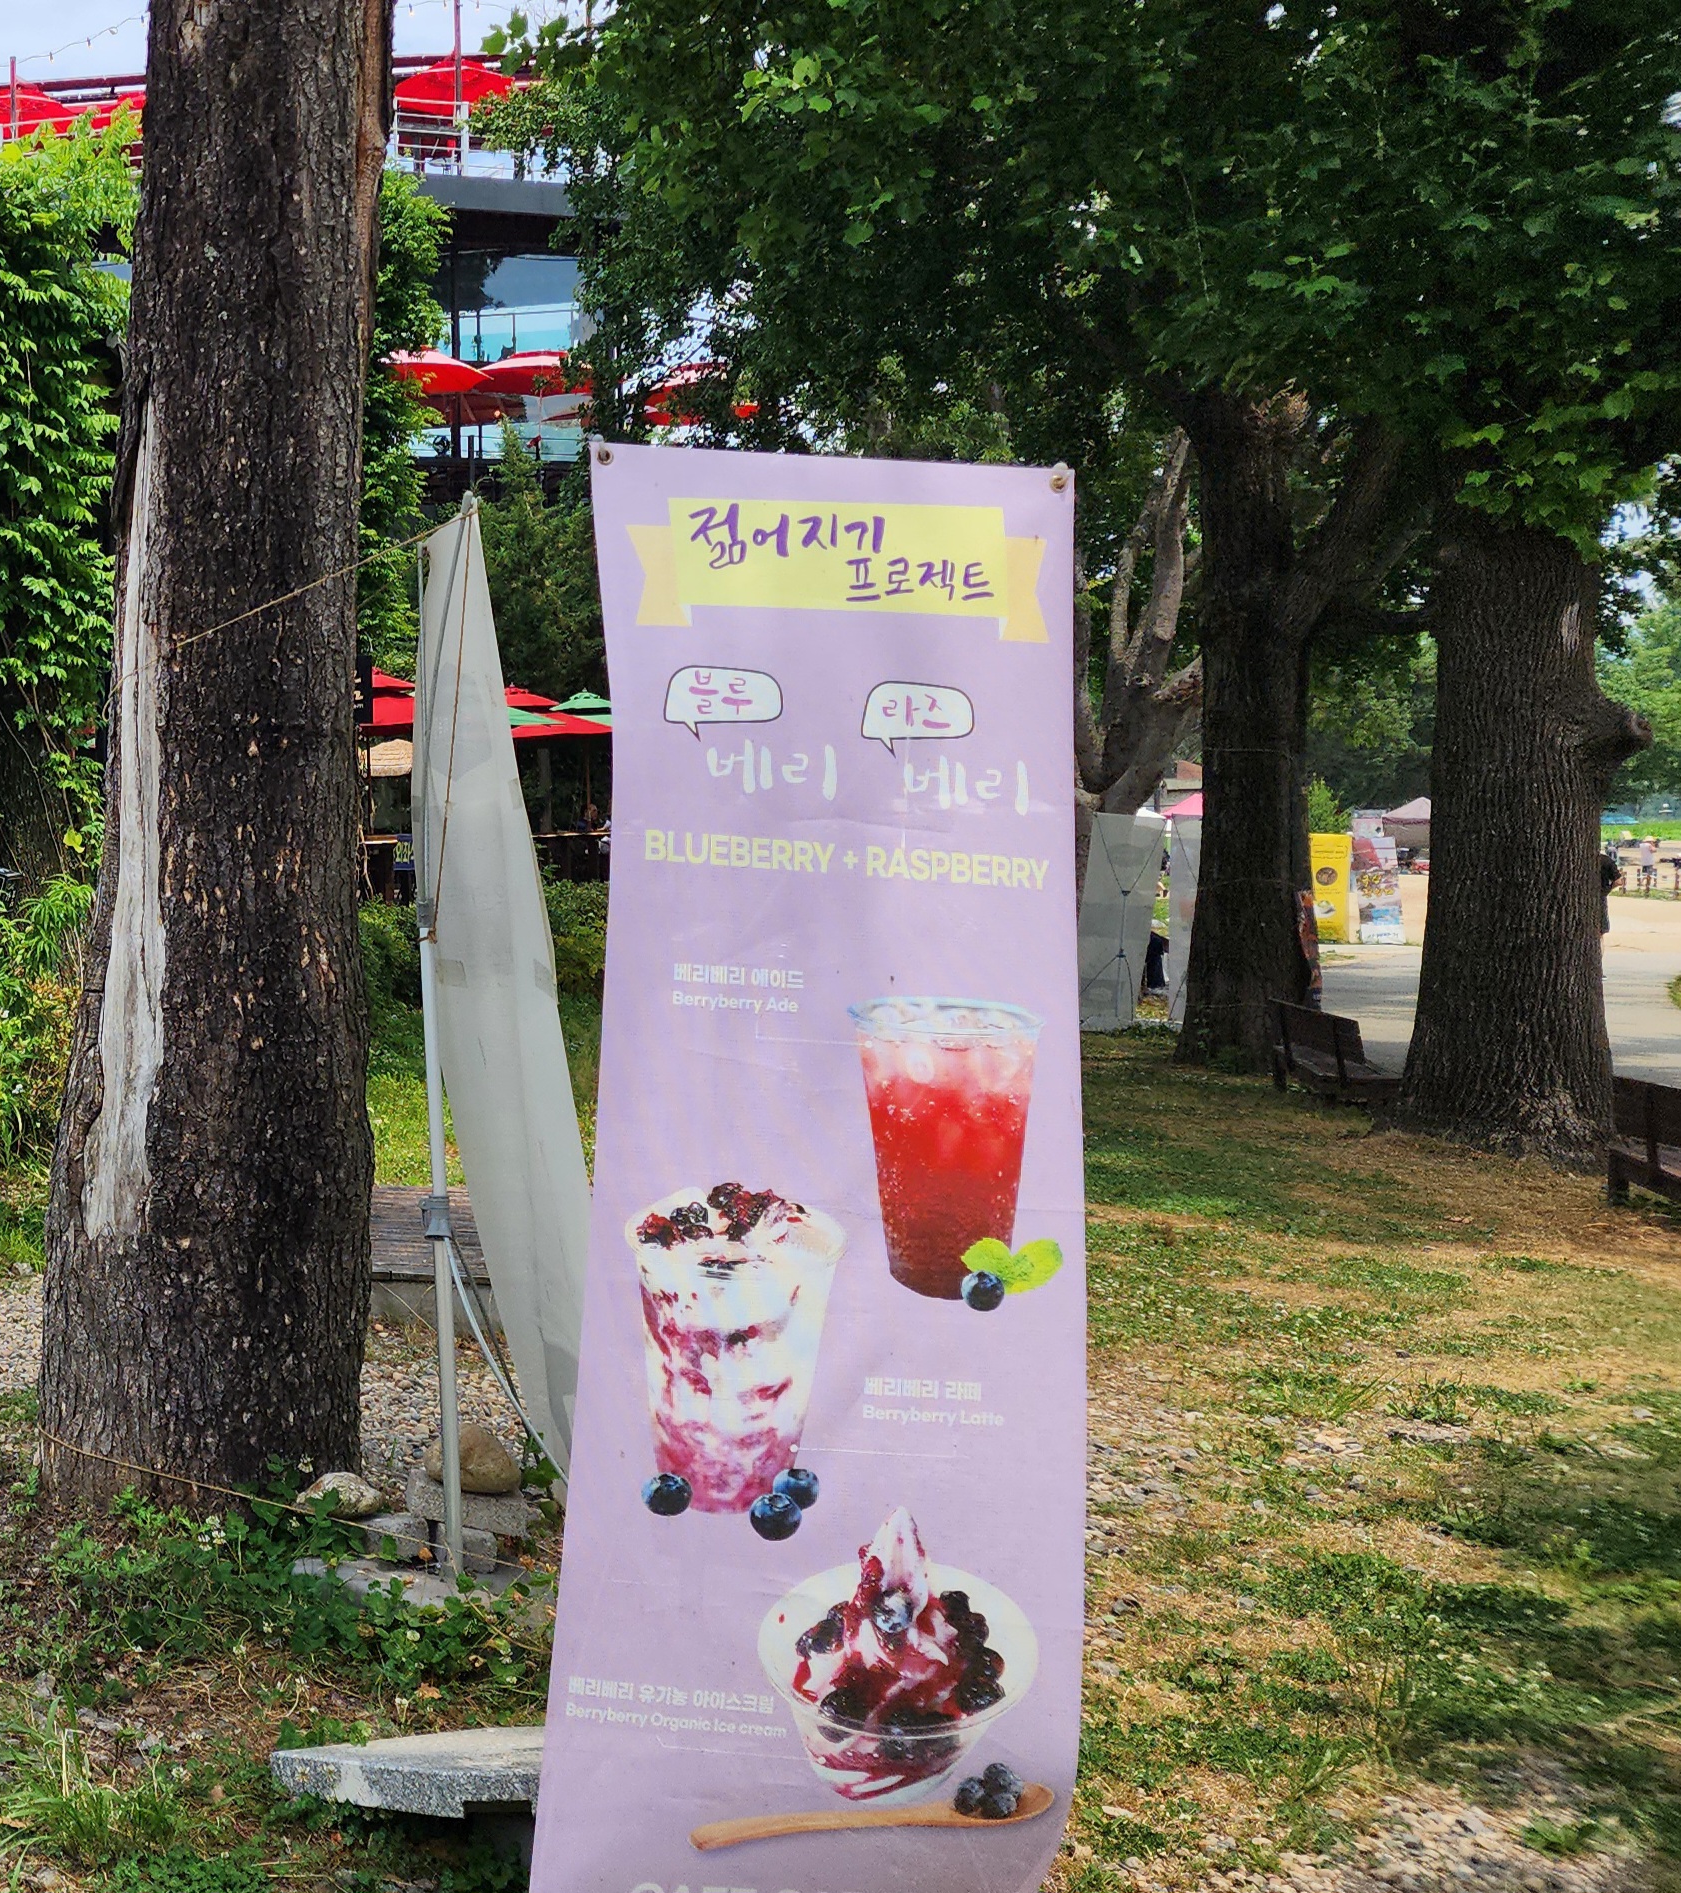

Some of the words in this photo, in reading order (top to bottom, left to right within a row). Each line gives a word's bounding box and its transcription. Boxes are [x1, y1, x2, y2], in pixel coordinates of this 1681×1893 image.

[688, 502, 886, 570] 젊어지기
[845, 556, 995, 602] 프로젝트
[688, 669, 754, 716] 블루
[881, 692, 951, 730] 라즈
[706, 738, 839, 801] 베리
[903, 754, 1029, 816] 베리
[644, 829, 836, 873] BLUEBERRY
[866, 845, 1050, 890] RASPBERRY
[673, 963, 746, 986] 베리베리
[751, 968, 804, 989] 에이드
[672, 990, 763, 1014] Berryberry
[765, 996, 799, 1013] Ade
[863, 1376, 939, 1400] 베리베리
[945, 1380, 982, 1402] 라떼
[862, 1403, 957, 1427] Berryberry
[959, 1408, 1005, 1427] Latte
[568, 1675, 635, 1701] 베리베리
[638, 1683, 689, 1706] 유기농
[692, 1690, 774, 1715] 아이스크림
[565, 1701, 647, 1728] Berryberry
[650, 1711, 712, 1732] Organic
[714, 1718, 736, 1734] Ice
[738, 1723, 787, 1738] cream
